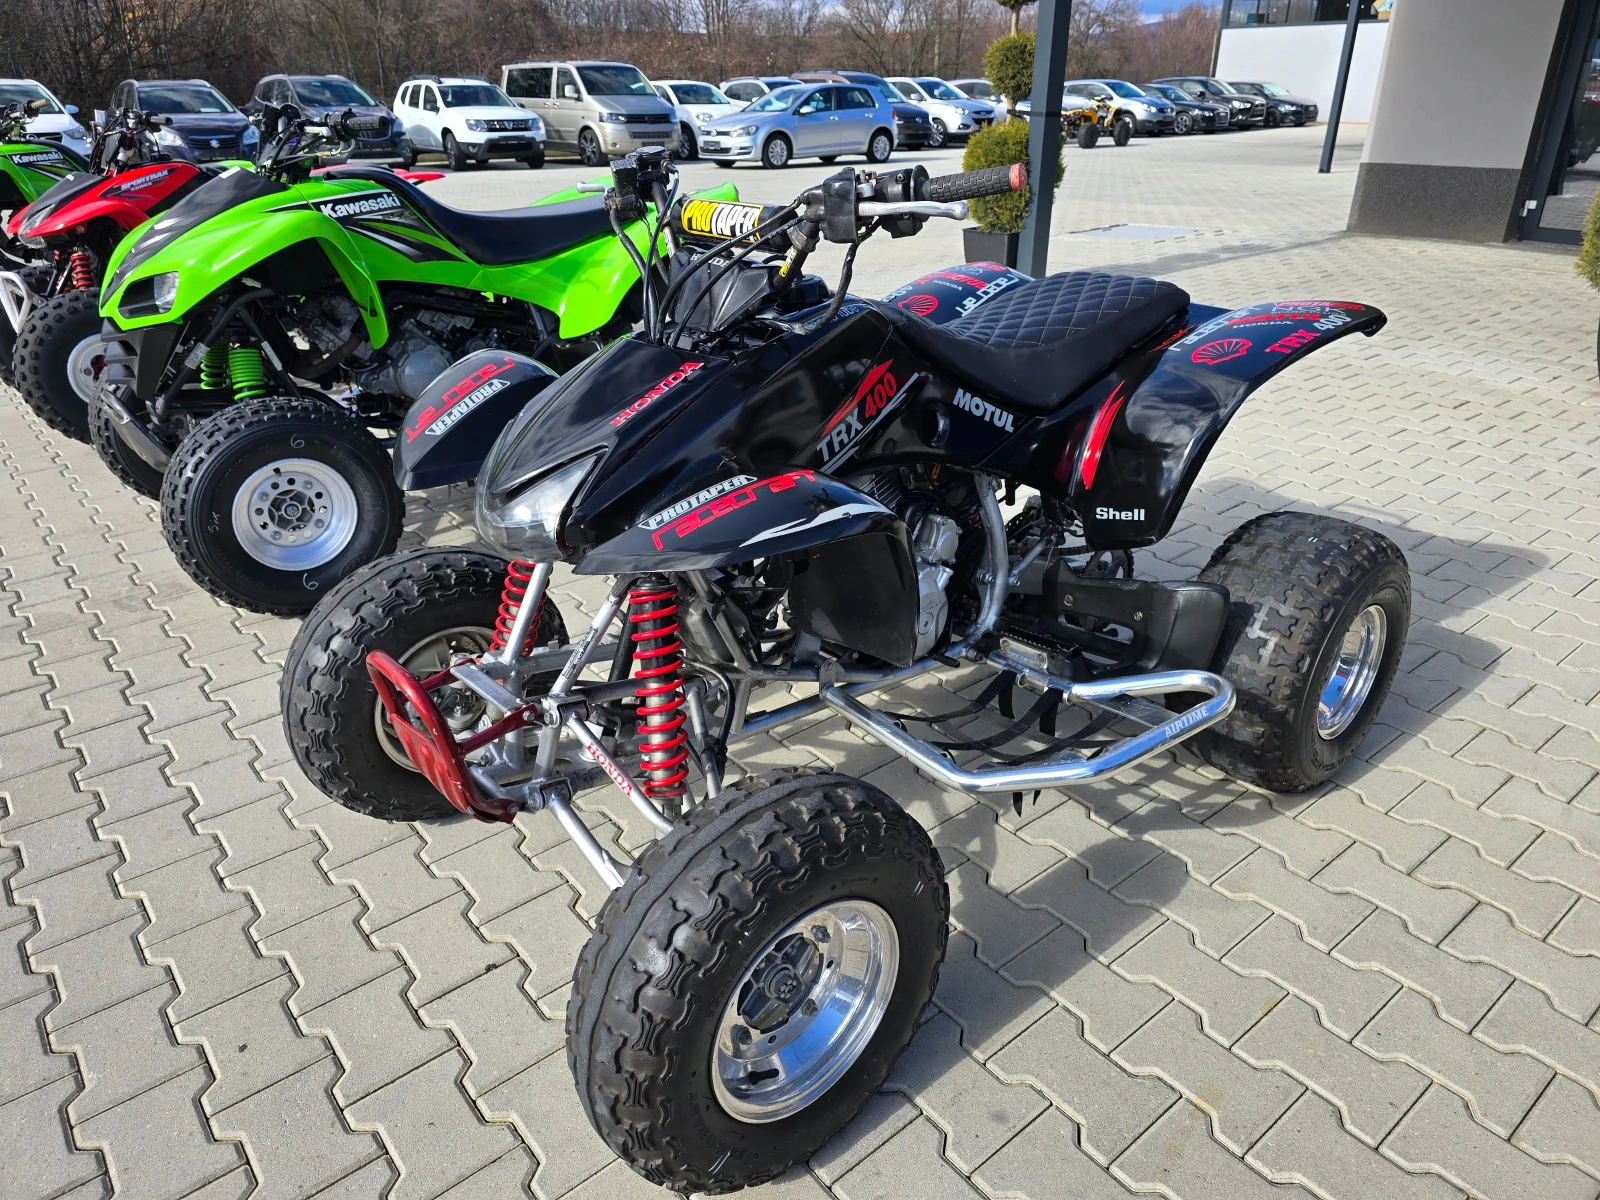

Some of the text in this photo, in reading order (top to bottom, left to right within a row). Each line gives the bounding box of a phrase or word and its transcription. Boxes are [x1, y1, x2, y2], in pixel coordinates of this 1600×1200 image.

[12, 151, 63, 164] Kawasaki
[121, 170, 169, 191] SPORTRAX
[320, 193, 401, 218] Kawasaki
[683, 200, 760, 243] PROTAPER
[932, 279, 963, 291] HONDA
[1226, 313, 1324, 327] MOTUL
[1264, 314, 1352, 354] TRX 400
[431, 379, 503, 434] PROTAPER
[609, 361, 704, 427] HONDA
[953, 388, 1015, 433] MOTUL
[816, 371, 897, 462] TRX 400
[290, 433, 305, 449] 6
[648, 475, 750, 529] PROTAPER
[1095, 507, 1145, 521] Shell
[302, 572, 319, 590] 6
[1164, 705, 1209, 738] AIRTIME
[587, 741, 633, 797] HONDA
